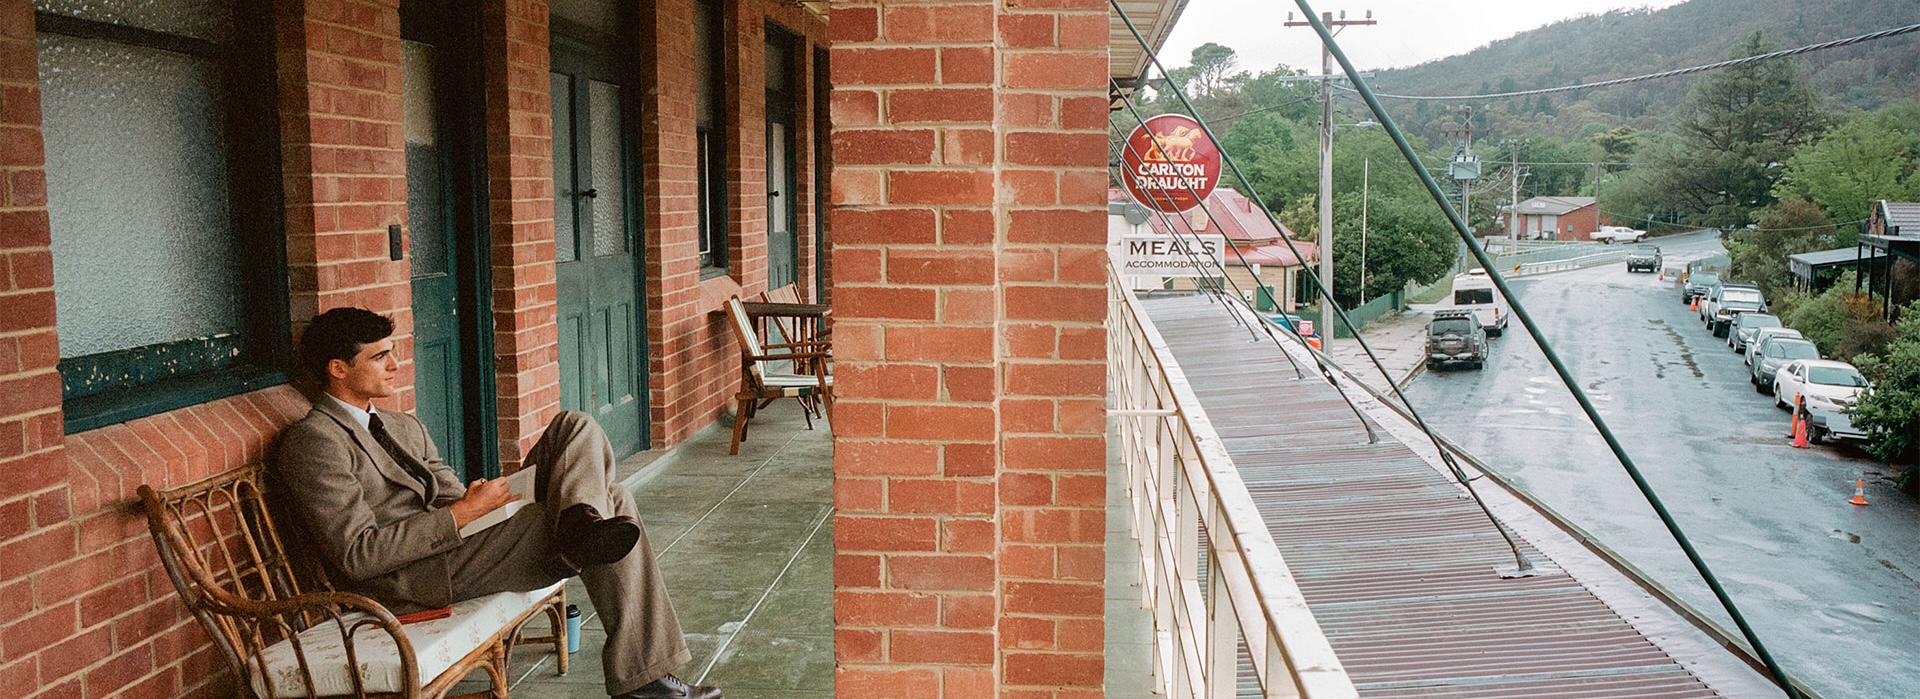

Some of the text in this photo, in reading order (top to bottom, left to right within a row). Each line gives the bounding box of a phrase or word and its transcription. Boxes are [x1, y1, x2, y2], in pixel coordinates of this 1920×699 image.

[1138, 163, 1204, 176] CARLTON
[1135, 177, 1208, 190] DRAUGHT
[1130, 241, 1216, 255] MEALS
